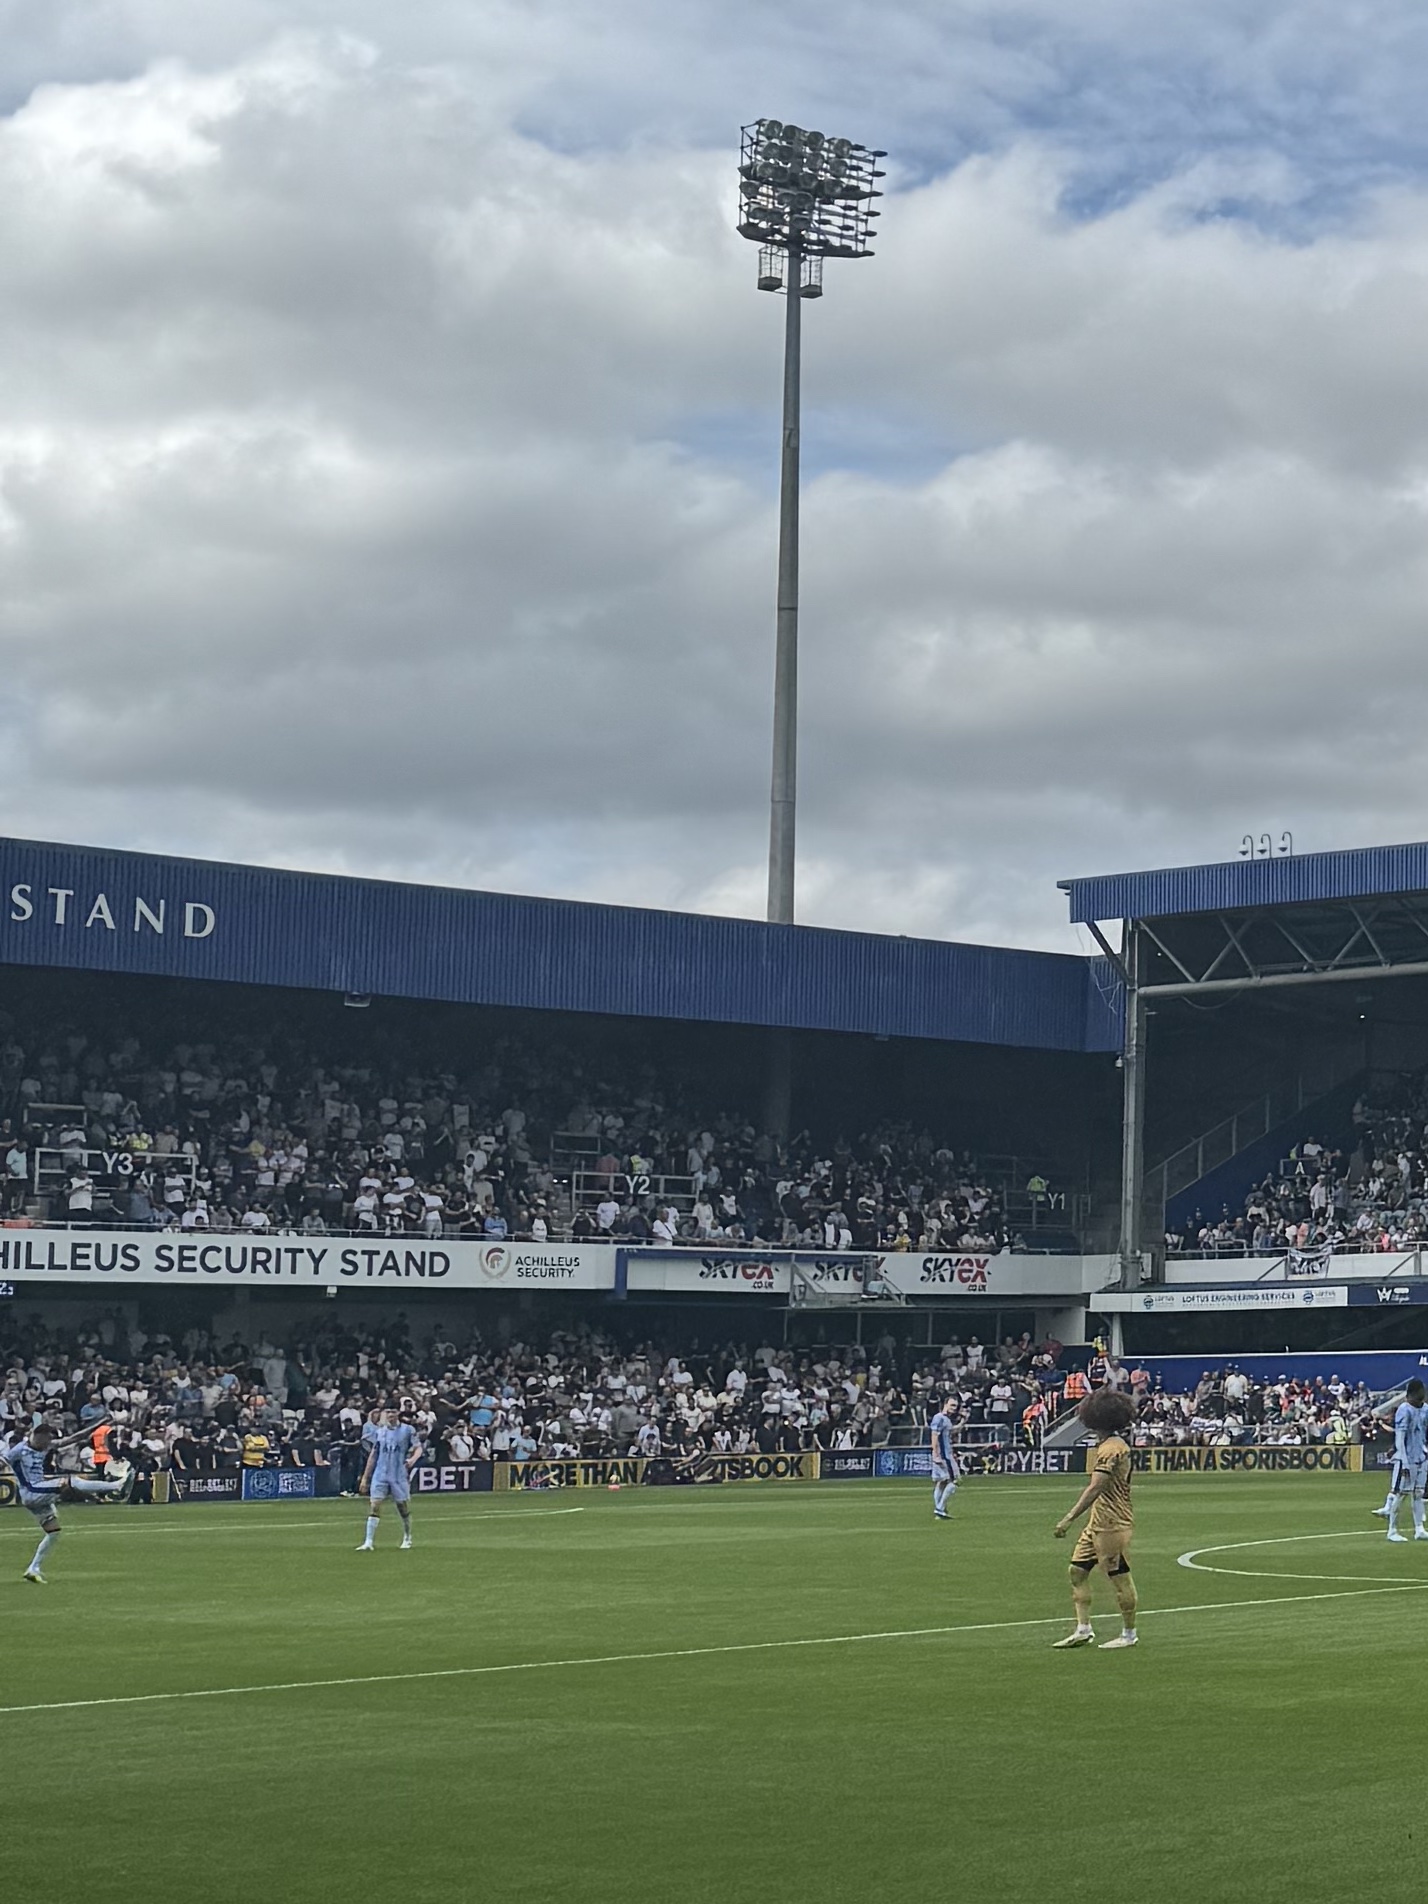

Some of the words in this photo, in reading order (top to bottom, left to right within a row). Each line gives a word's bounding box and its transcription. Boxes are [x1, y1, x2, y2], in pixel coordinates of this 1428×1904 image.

[10, 883, 216, 938] STAND
[102, 1152, 134, 1175] Y3
[625, 1175, 651, 1195] Y2
[1047, 1193, 1065, 1210] Y1
[154, 1243, 328, 1276] SECURITY
[339, 1248, 451, 1278] STAND
[514, 1255, 581, 1268] ACHILLEUS
[1153, 1448, 1200, 1472] THAN
[1203, 1448, 1217, 1471] A
[1220, 1447, 1349, 1471] SPORTSBOOK
[579, 1461, 639, 1487] THAN
